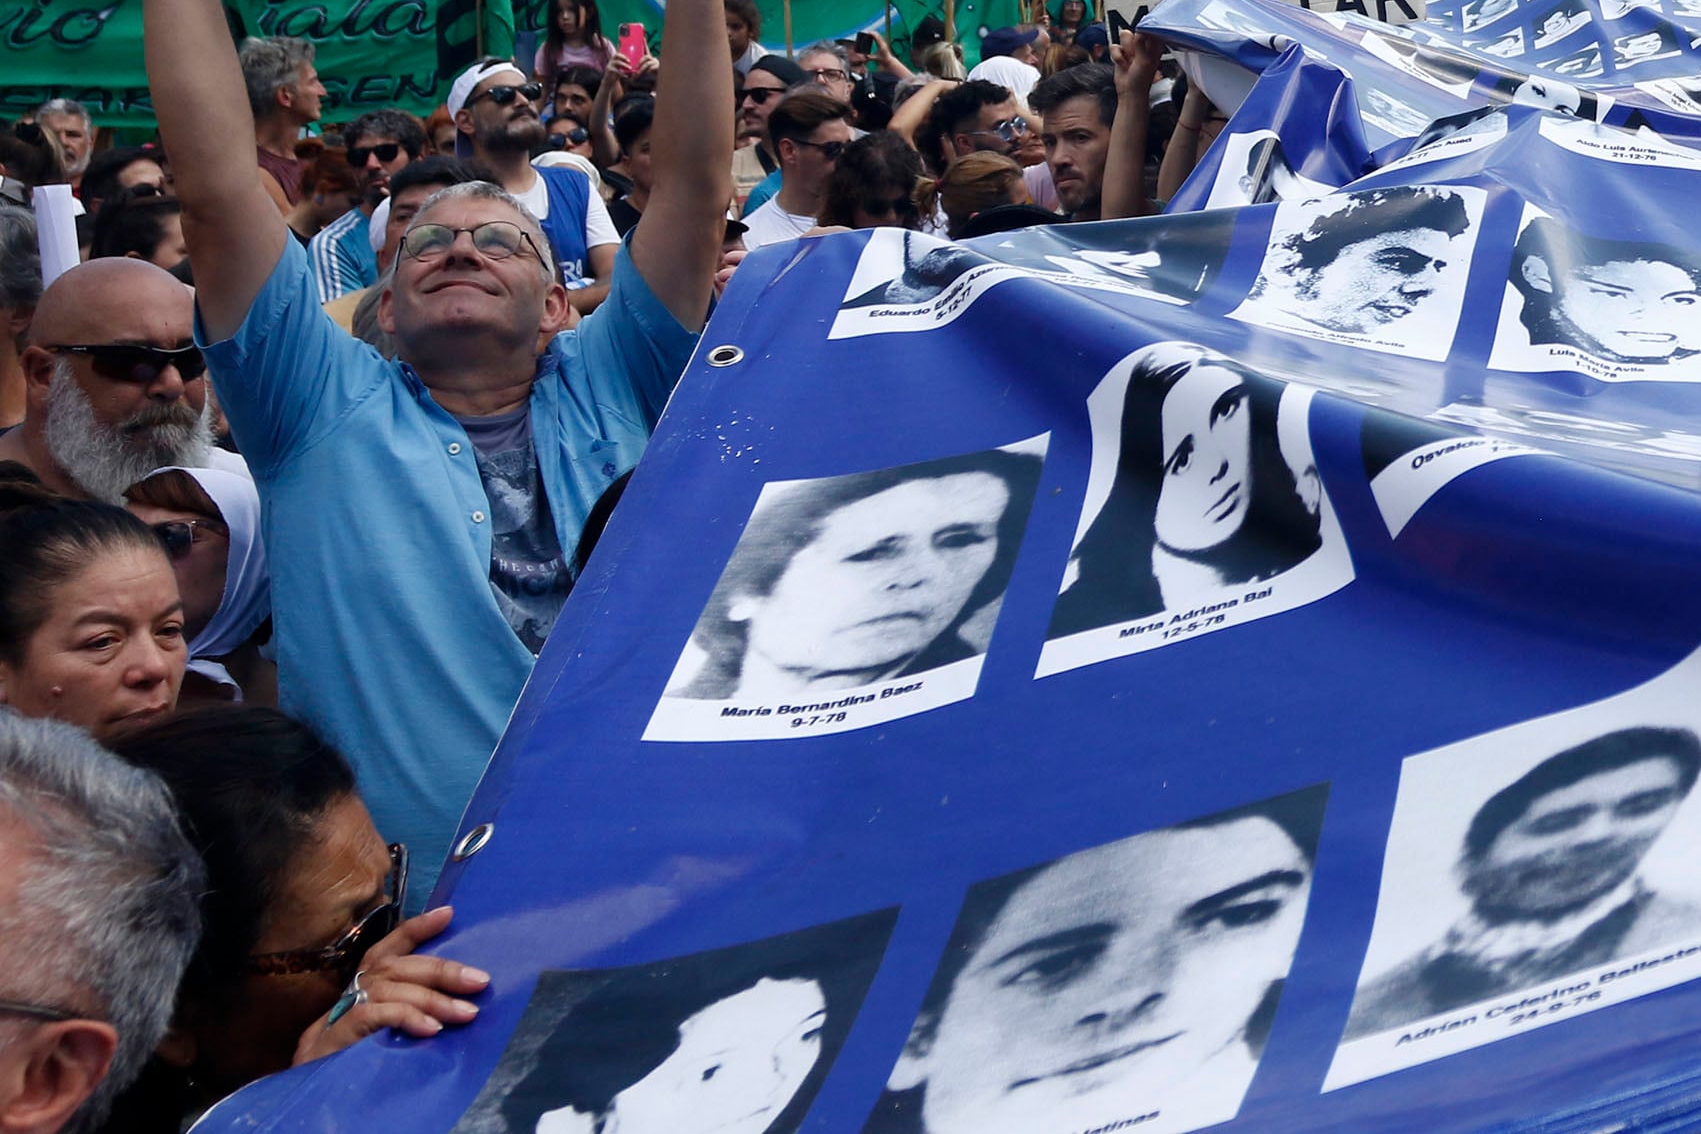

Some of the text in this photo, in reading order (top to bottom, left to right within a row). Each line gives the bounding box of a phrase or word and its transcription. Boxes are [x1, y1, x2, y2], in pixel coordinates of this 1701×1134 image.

[1576, 138, 1600, 148] Aldo
[1603, 144, 1626, 152] Luis
[869, 307, 931, 318] Eduardo
[933, 281, 965, 311] Emilio
[1549, 348, 1576, 356] Luis
[1411, 440, 1486, 470] Osvaldo
[1118, 618, 1166, 639] Mirta
[1170, 597, 1239, 626] Adriana
[1160, 613, 1226, 640] 12-5-78
[776, 693, 876, 715] Bernardina
[880, 680, 924, 698] Baez
[790, 711, 847, 728] 9-7-78
[1485, 980, 1591, 1019] Ceferino
